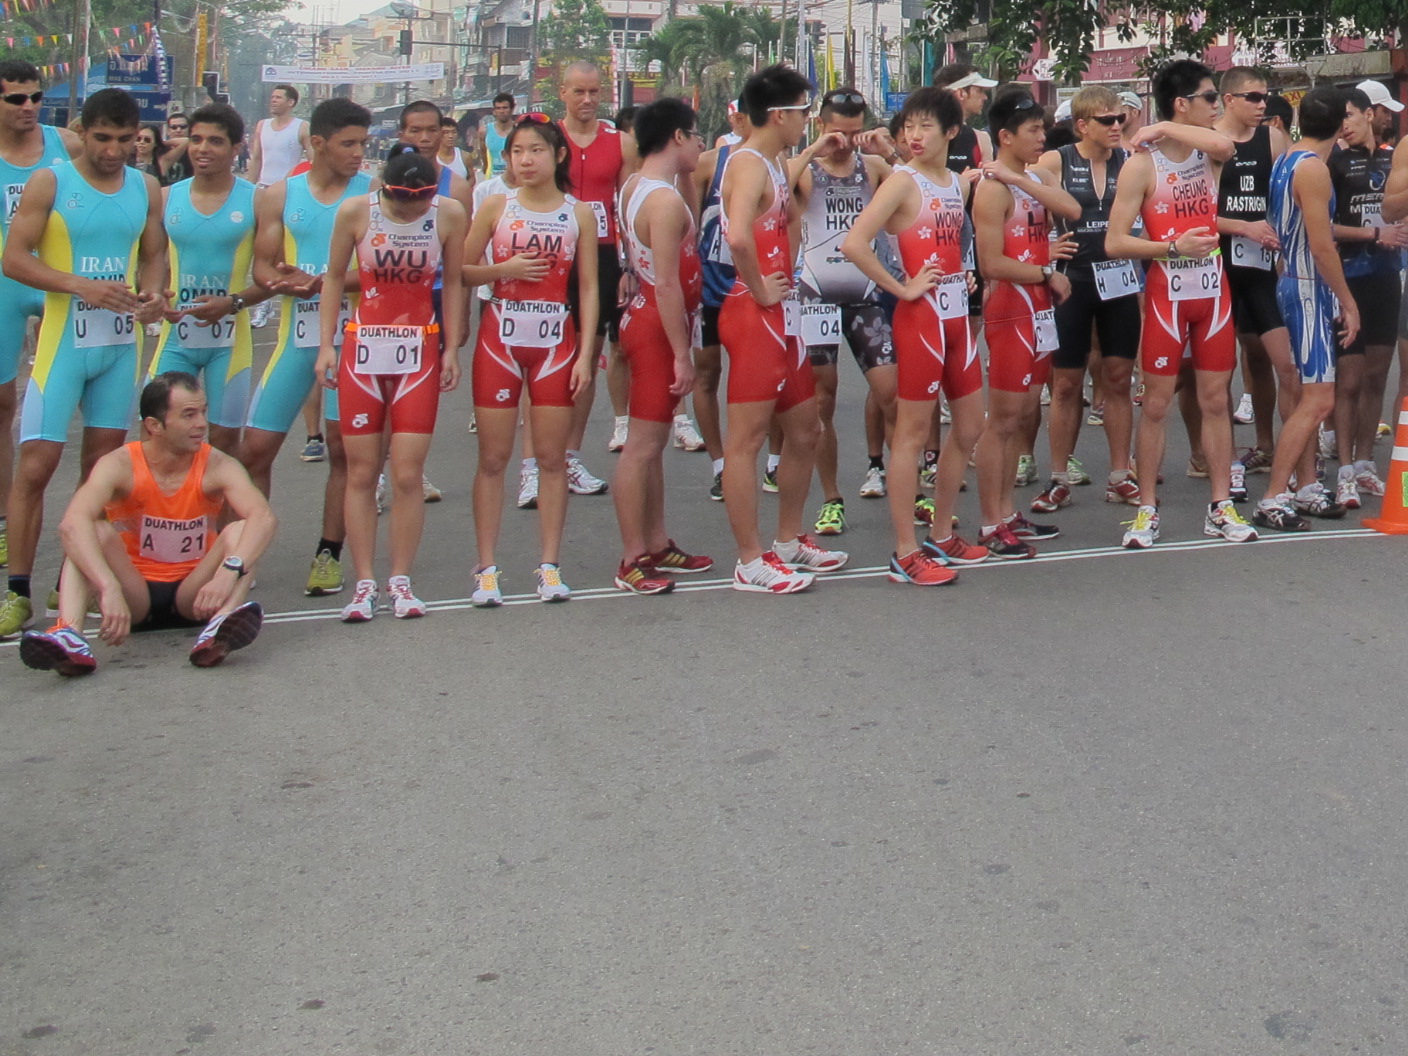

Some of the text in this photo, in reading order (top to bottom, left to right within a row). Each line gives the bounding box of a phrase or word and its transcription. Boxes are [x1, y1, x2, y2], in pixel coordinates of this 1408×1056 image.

[1172, 179, 1208, 201] CHEUNG
[1239, 175, 1256, 192] UZB
[826, 197, 864, 213] WONG
[1174, 198, 1209, 218] HKG
[1226, 196, 1267, 211] RASTRIGIN
[934, 212, 963, 229] WONG
[388, 233, 433, 242] Champion
[392, 240, 429, 248] System
[511, 232, 563, 254] LAM
[374, 248, 428, 269] WU
[1234, 243, 1245, 259] C
[1260, 246, 1271, 263] 15
[80, 256, 126, 273] IRAN
[1170, 257, 1214, 270] DUATHLON
[181, 273, 226, 288] IRAN
[374, 269, 423, 284] HKG
[1098, 278, 1106, 293] H
[1122, 270, 1137, 287] 04
[1170, 274, 1182, 293] C
[1201, 272, 1219, 290] 02
[505, 302, 561, 314] DUATHLON
[939, 292, 950, 311] C
[75, 319, 87, 339] U
[114, 315, 135, 335] 05
[178, 321, 189, 340] C
[211, 320, 236, 339] 07
[297, 319, 306, 339] C
[360, 326, 418, 338] DUATHLON
[501, 317, 515, 337] D
[538, 320, 561, 340] 04
[820, 319, 840, 337] 04
[1036, 325, 1043, 344] C
[357, 345, 370, 364] D
[396, 345, 419, 365] 01
[145, 517, 204, 531] DUATHLON
[142, 533, 155, 551] A
[180, 533, 205, 553] 21
